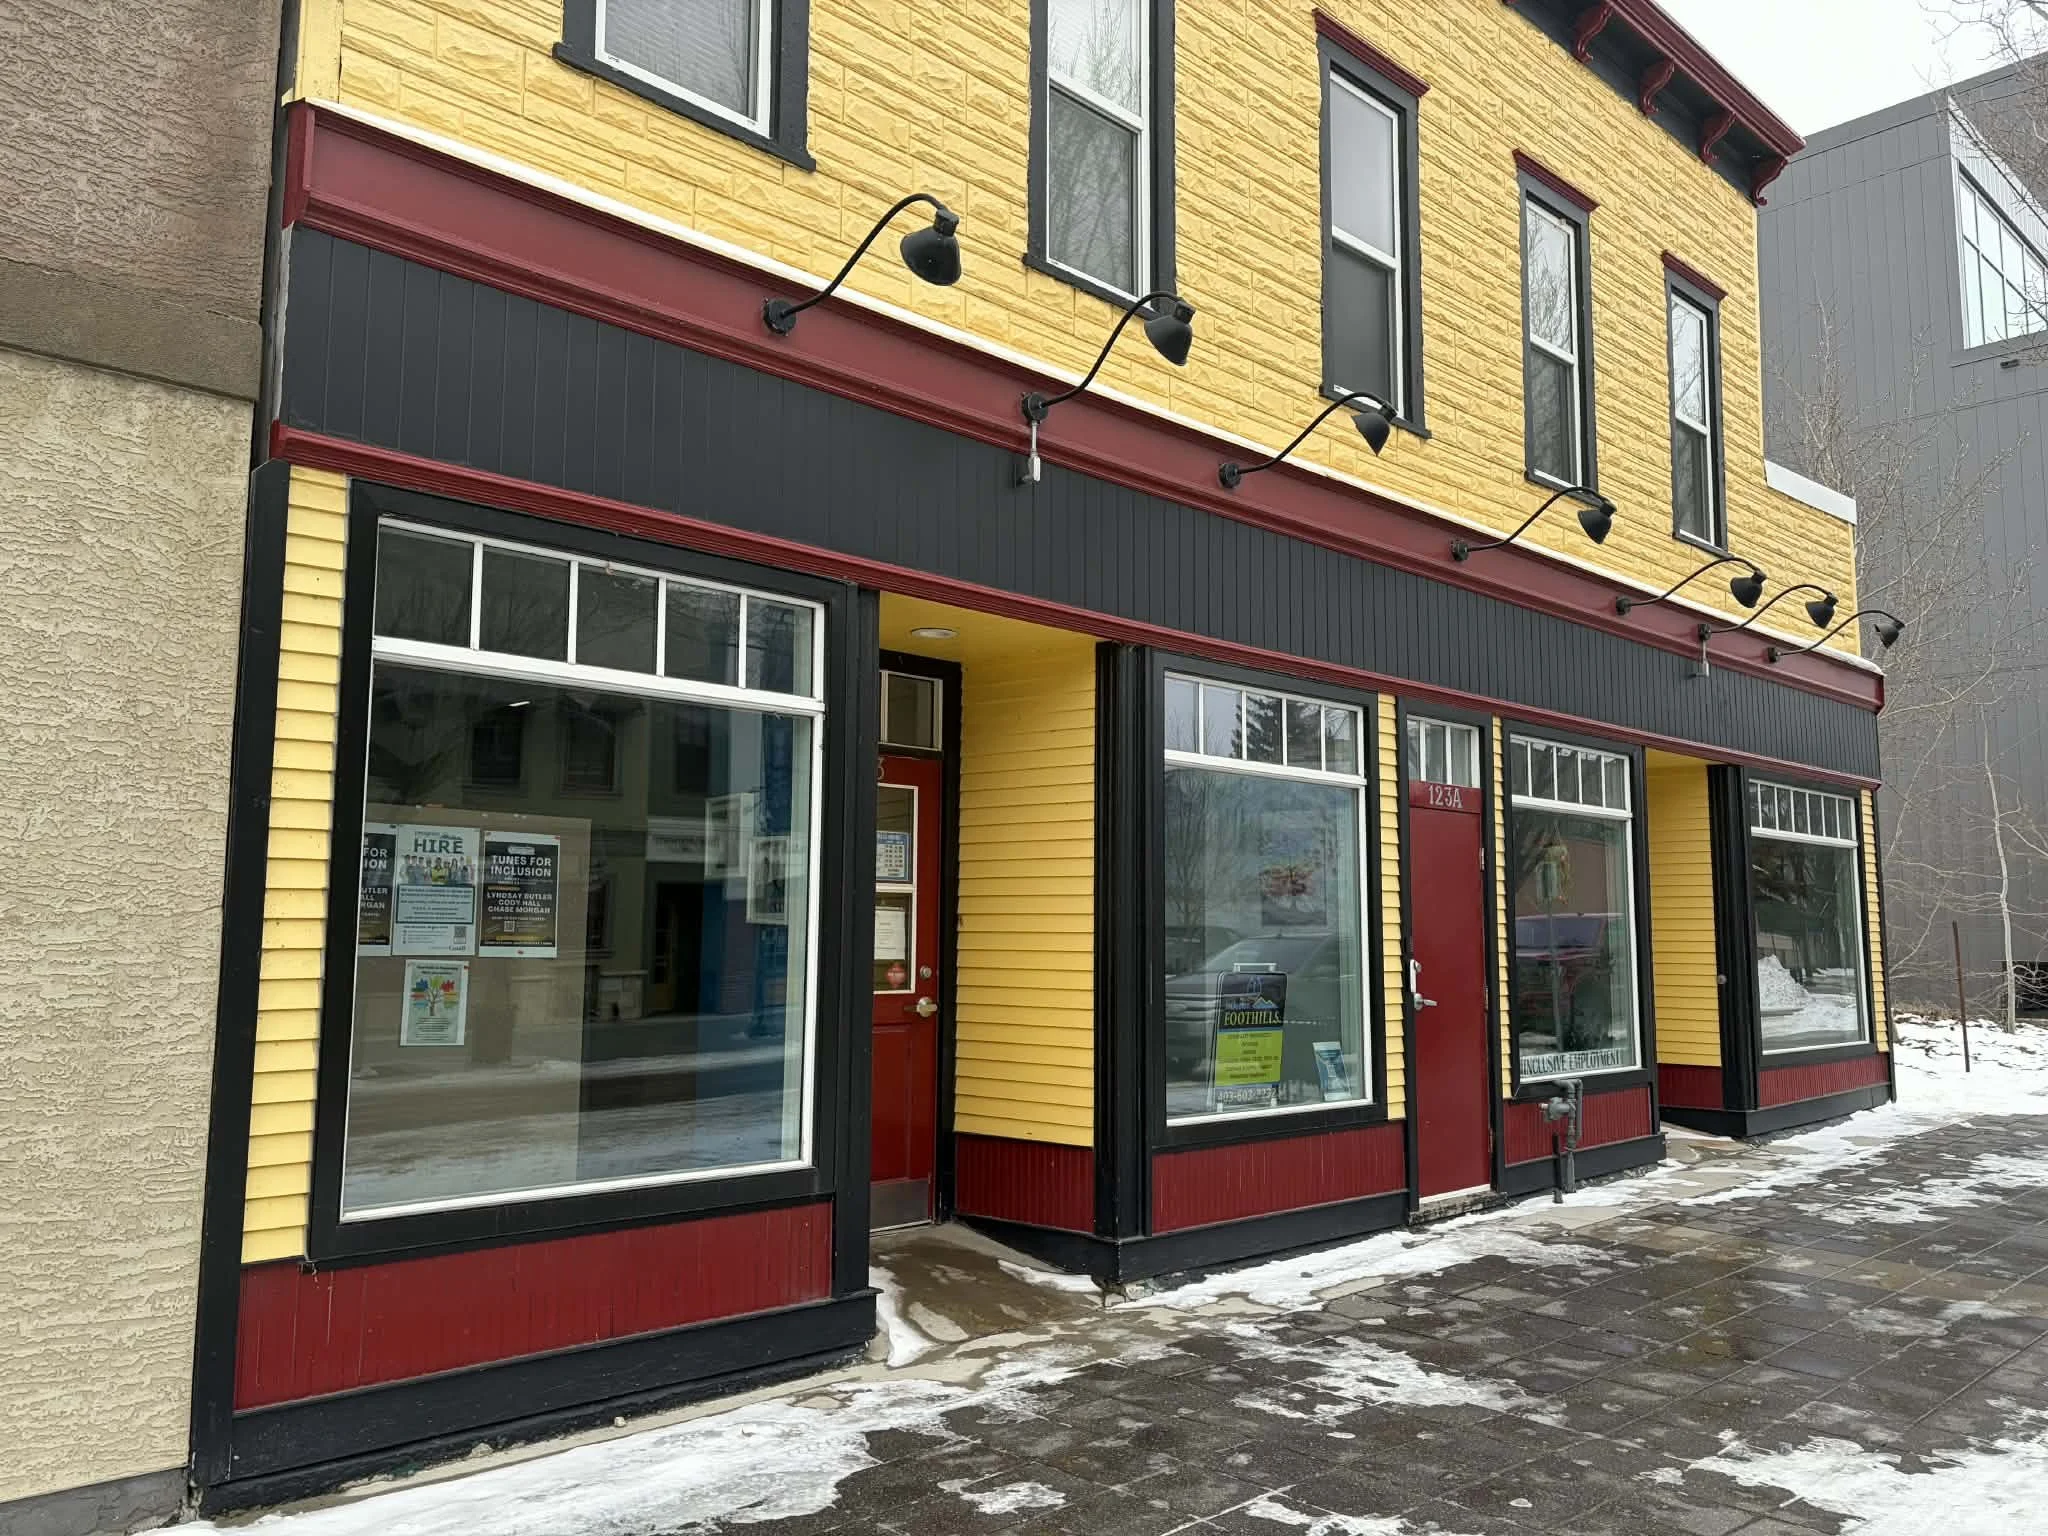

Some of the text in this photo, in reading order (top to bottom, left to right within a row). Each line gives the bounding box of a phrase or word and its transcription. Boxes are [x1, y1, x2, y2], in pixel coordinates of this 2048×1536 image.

[1428, 784, 1463, 809] 123A
[413, 838, 464, 854] HIRE
[362, 847, 388, 858] FOR
[492, 855, 552, 867] TUNES FOR
[490, 865, 552, 877] INCLUSION
[360, 901, 385, 909] RGAN
[487, 905, 551, 914] CHASE MORGAN
[1224, 1010, 1281, 1026] FOOTHILLS
[1522, 1049, 1620, 1076] INCLUSIVE EMPLOYMENT
